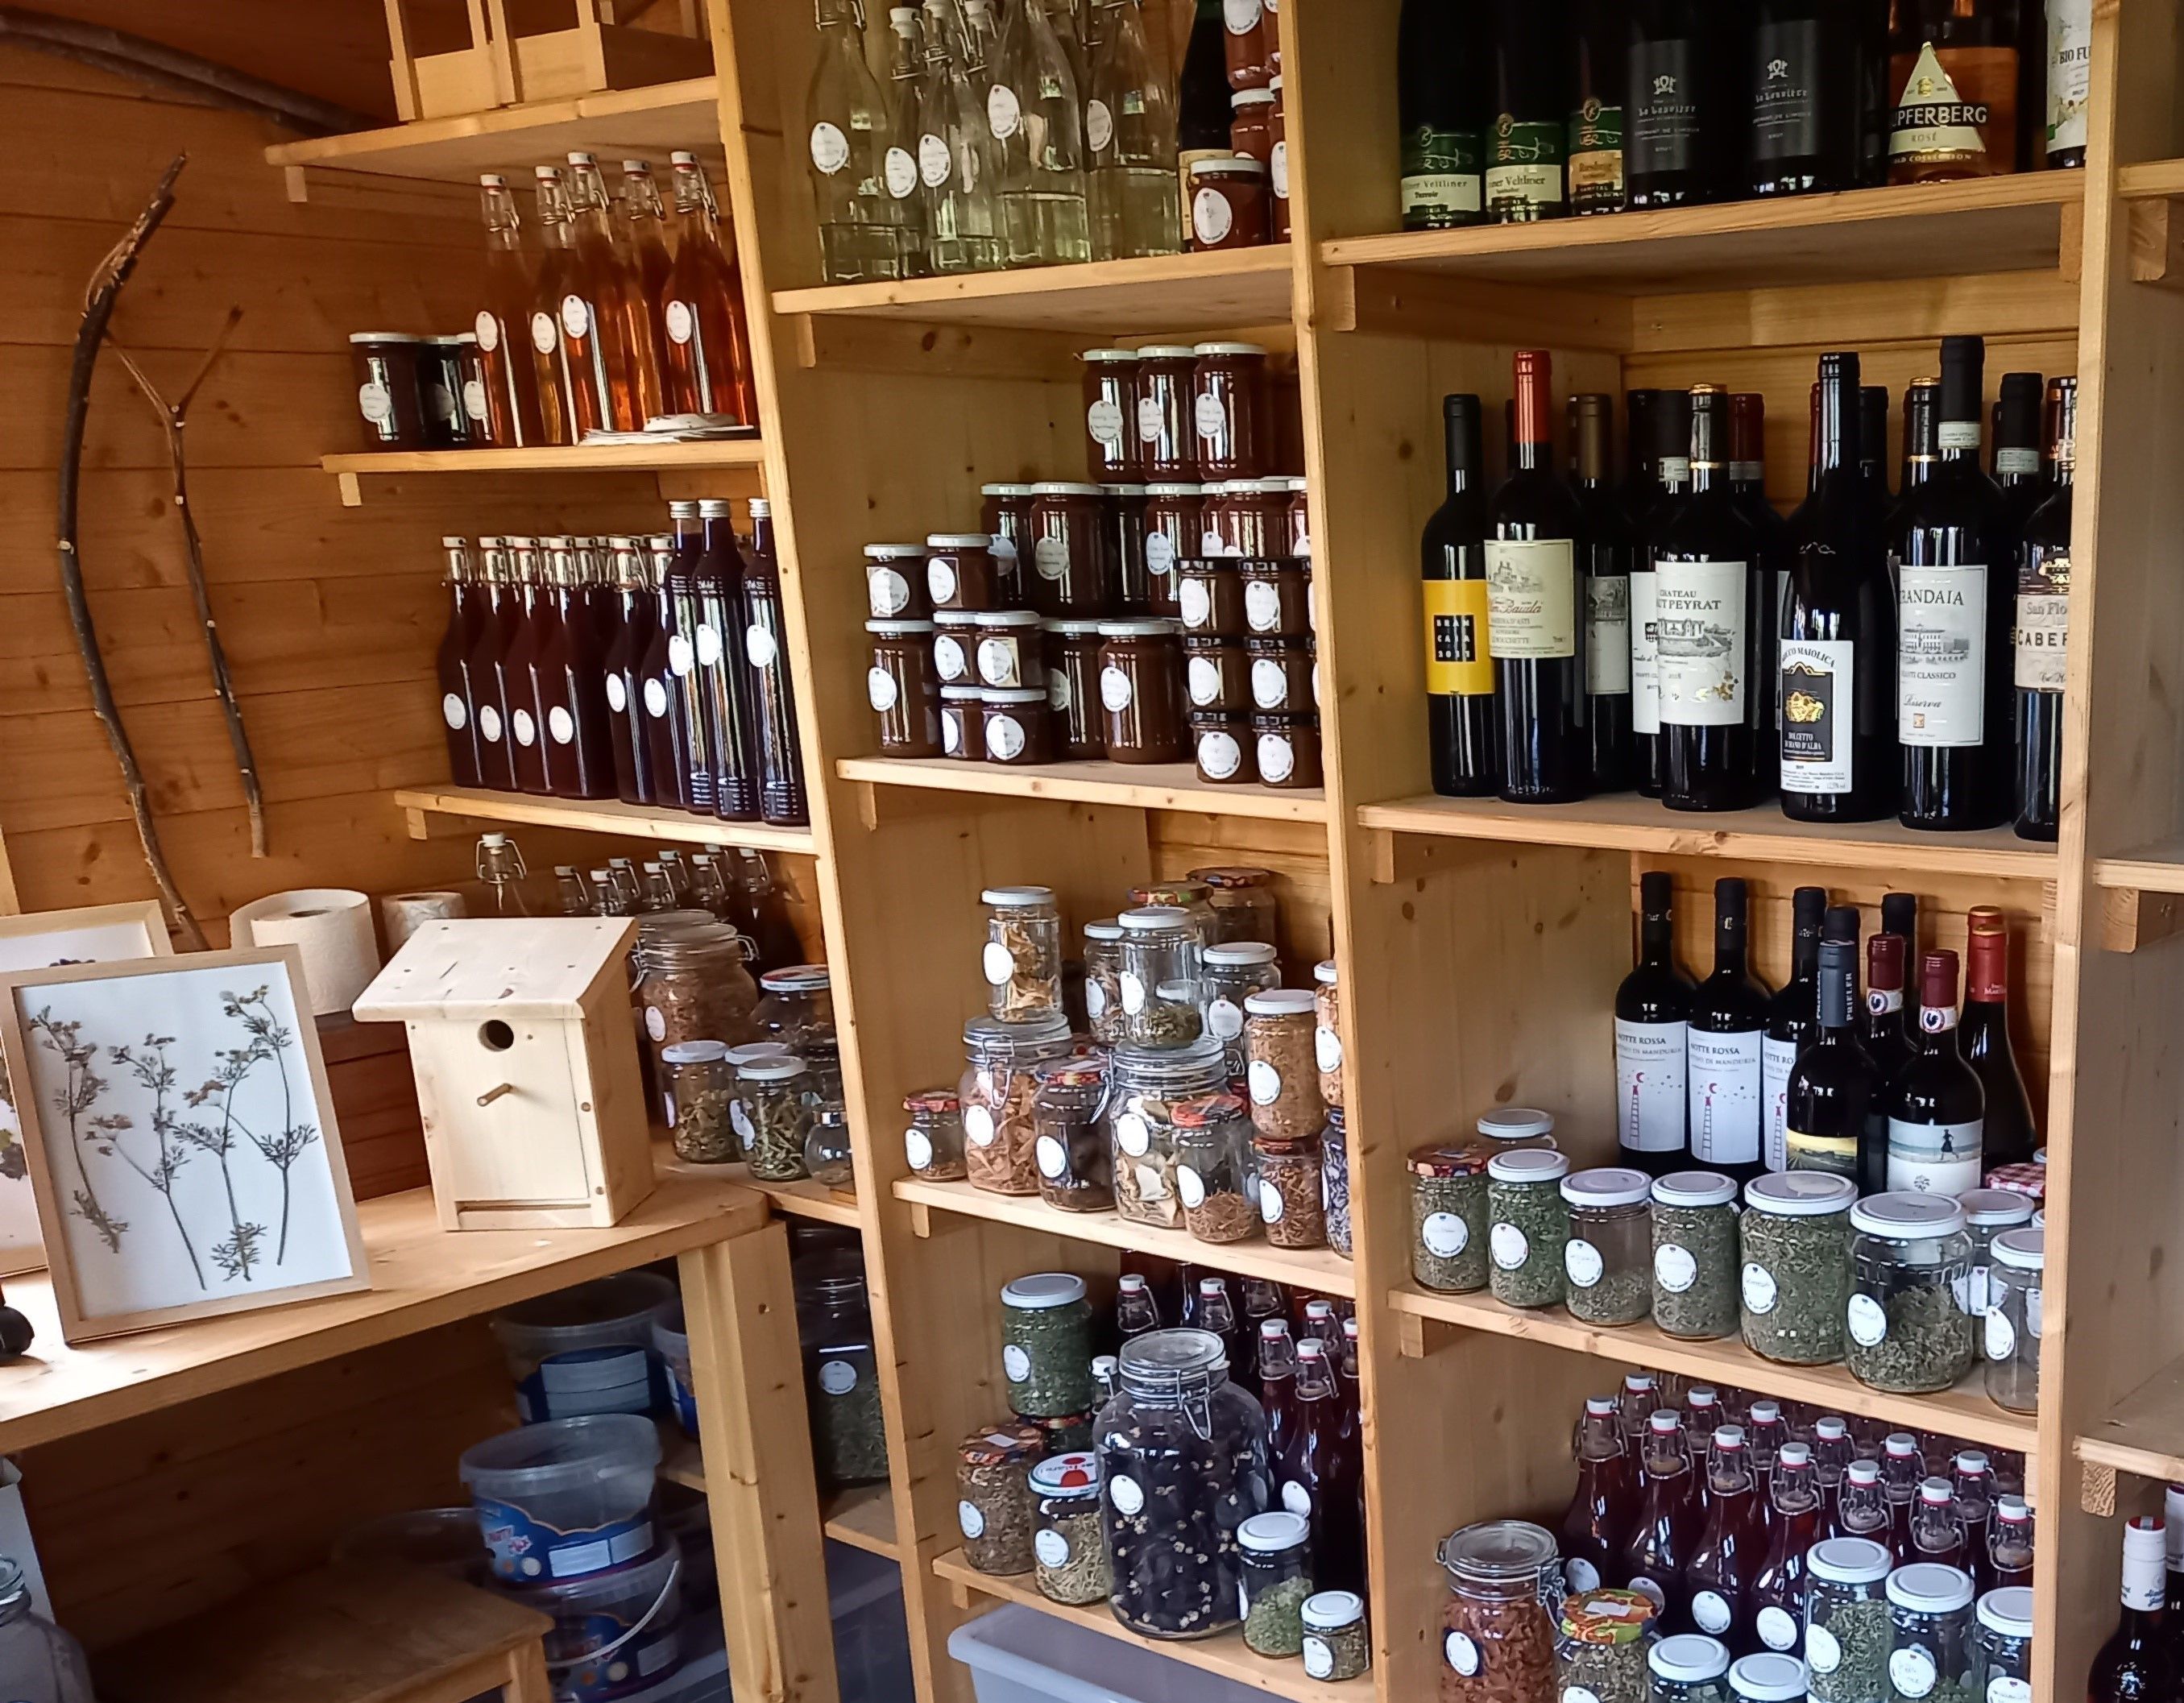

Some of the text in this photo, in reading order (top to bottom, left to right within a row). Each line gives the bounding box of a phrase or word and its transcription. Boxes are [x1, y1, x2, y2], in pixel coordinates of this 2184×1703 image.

[2058, 50, 2074, 64] BIO
[1424, 180, 1468, 189] Veltliner
[1917, 671, 1957, 680] CLASSICO
[1845, 972, 1854, 1021] PRIELER
[1639, 1037, 1667, 1046] ROSSA
[1712, 1046, 1741, 1056] ROSSA
